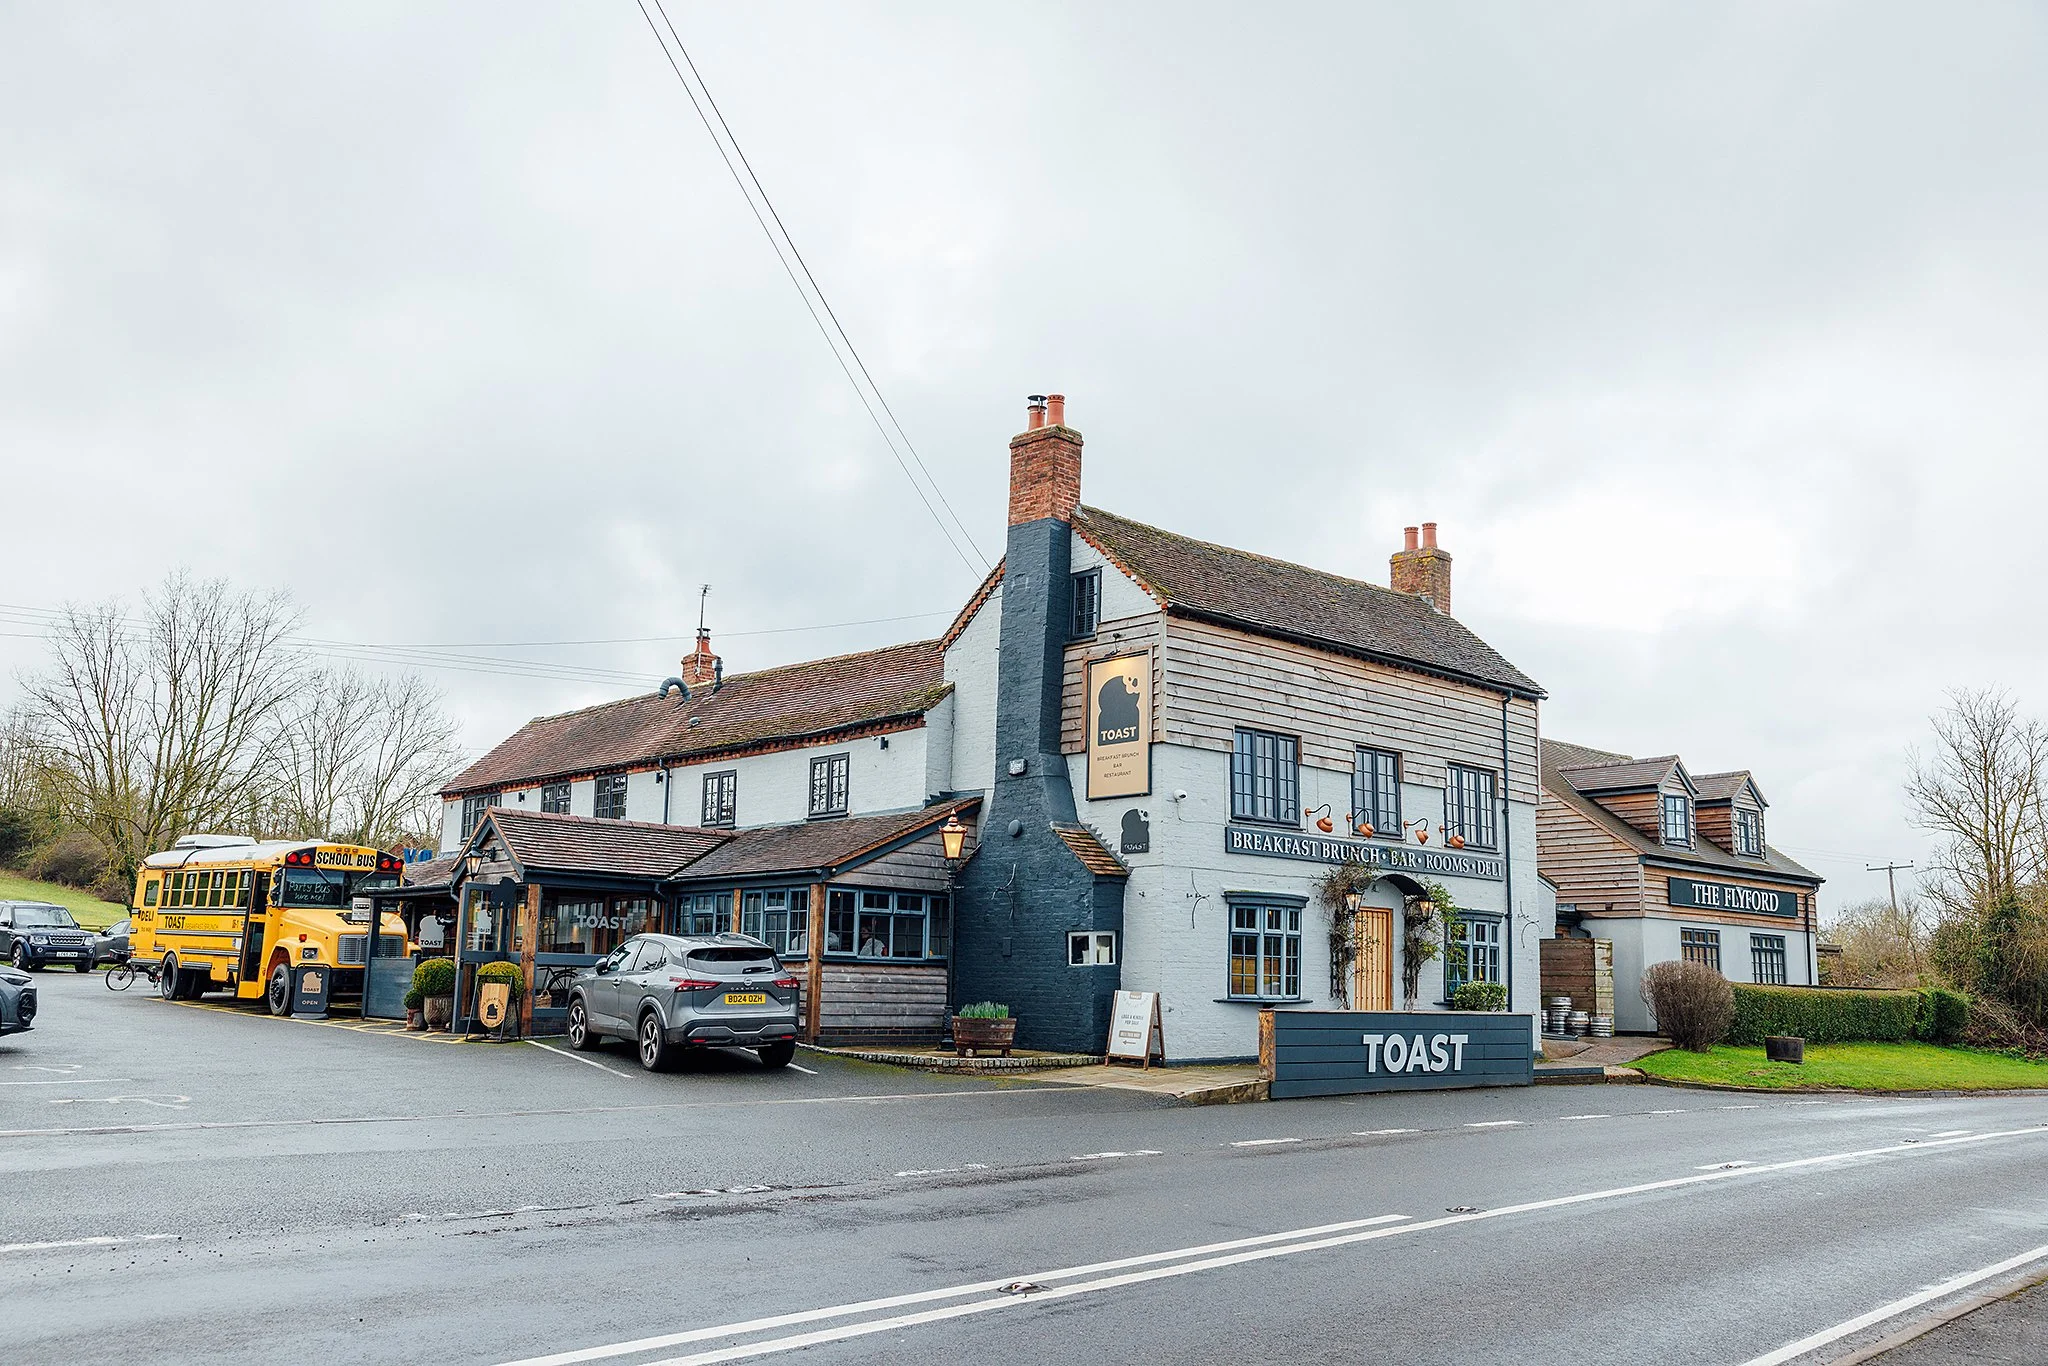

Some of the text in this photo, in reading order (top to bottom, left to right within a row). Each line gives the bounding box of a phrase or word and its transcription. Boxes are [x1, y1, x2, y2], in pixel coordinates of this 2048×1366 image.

[1101, 727, 1136, 741] TOAST
[316, 852, 375, 867] SCHOOL BUS
[1232, 831, 1502, 877] BREAKFAST BRUNCH BAR ROOMS DELI
[289, 881, 330, 893] Party Bus
[1692, 883, 1779, 912] THE FLYFORD
[140, 911, 154, 921] DELI
[165, 916, 186, 929] TOAST
[576, 914, 629, 930] TOAST
[1363, 1034, 1468, 1073] TOAST
